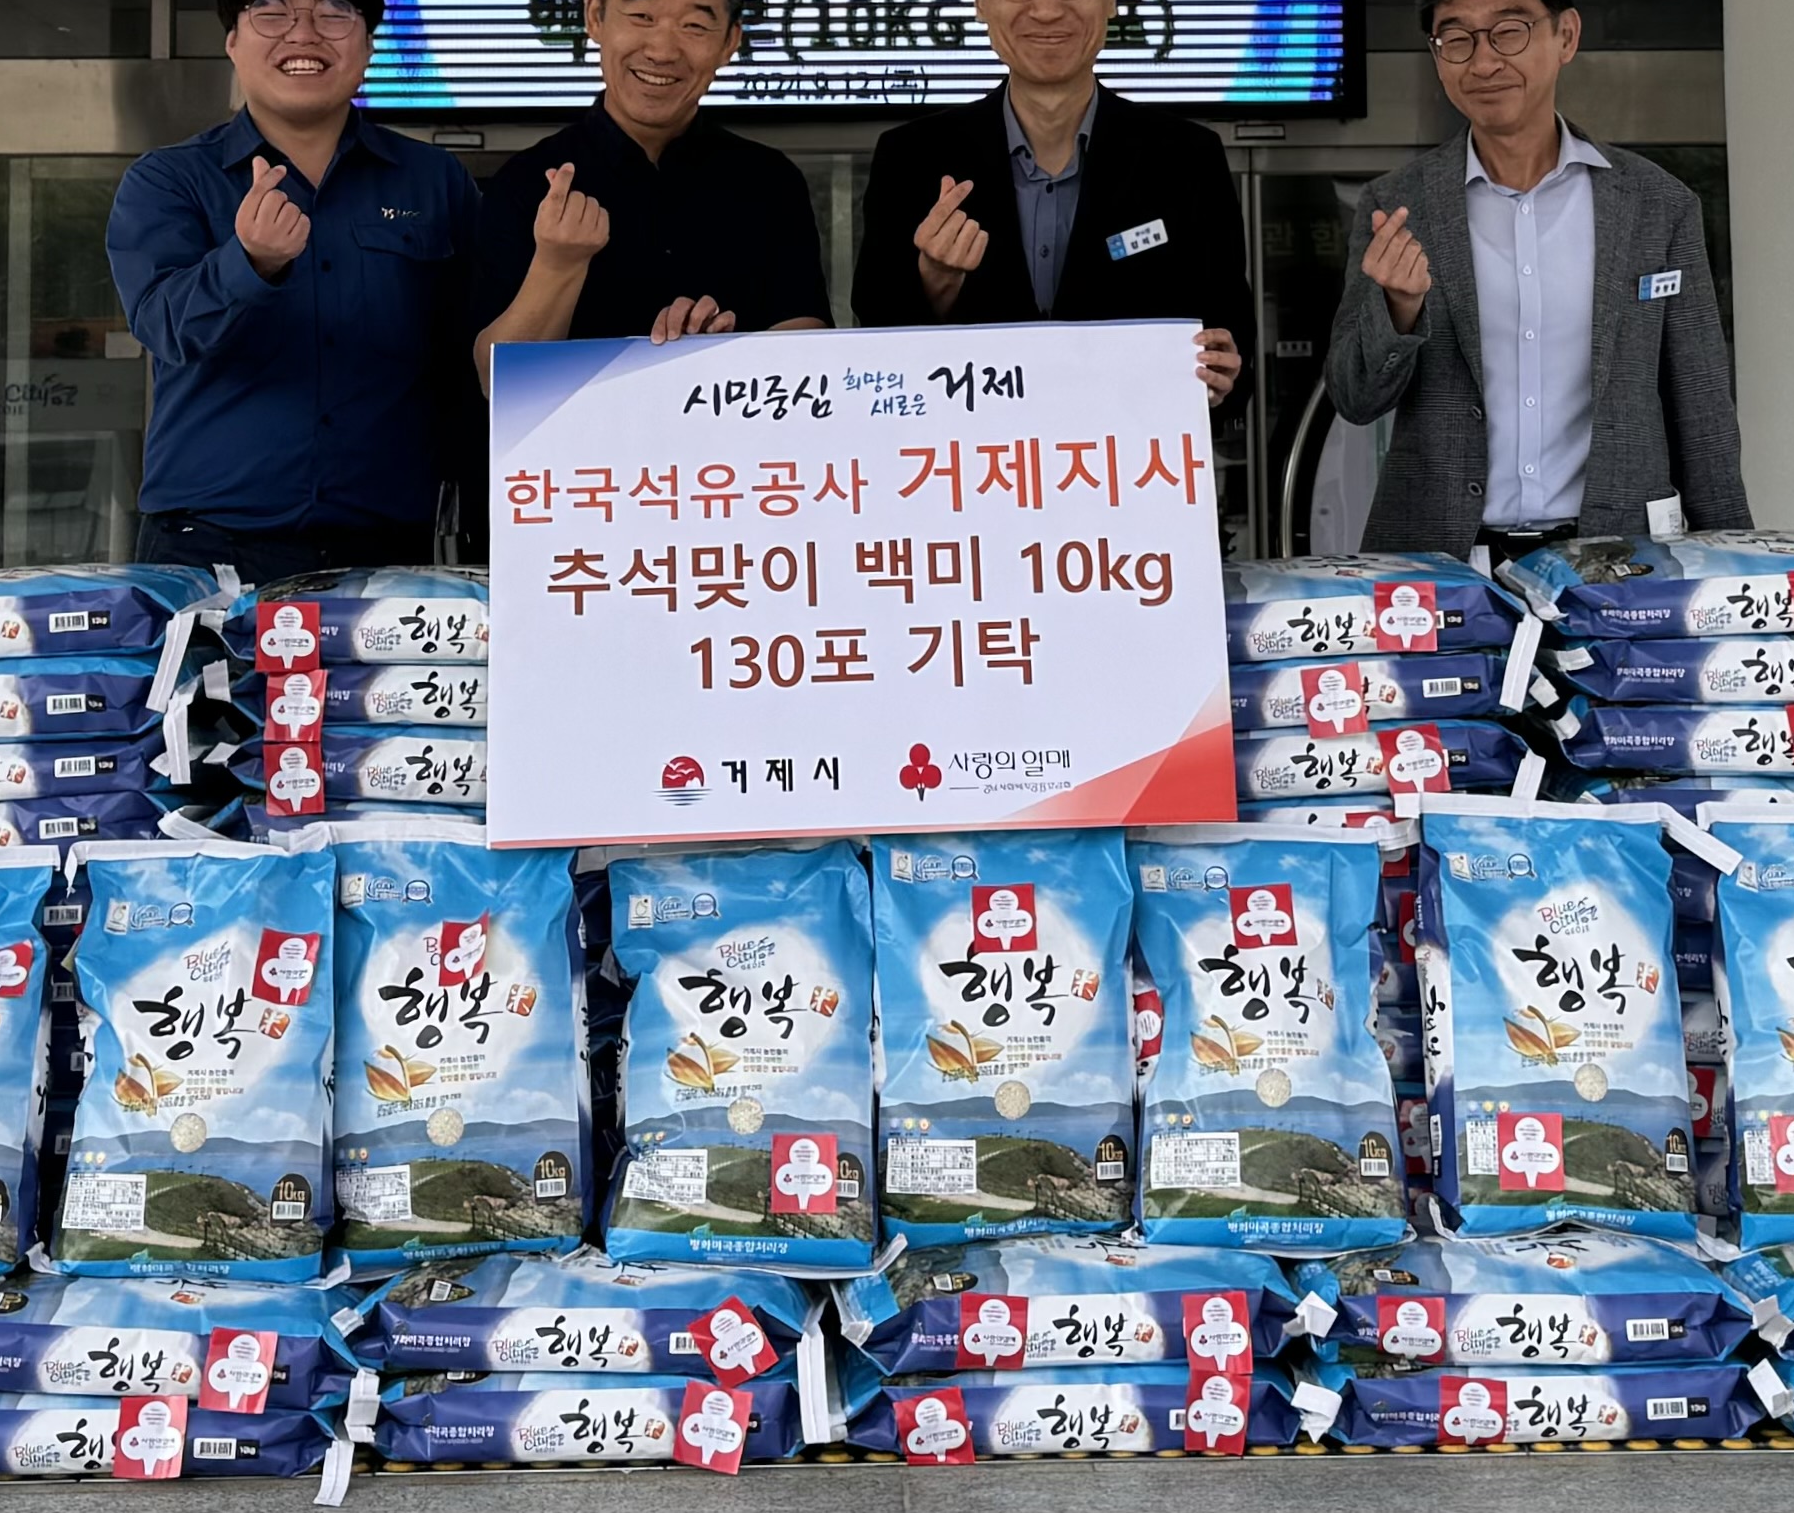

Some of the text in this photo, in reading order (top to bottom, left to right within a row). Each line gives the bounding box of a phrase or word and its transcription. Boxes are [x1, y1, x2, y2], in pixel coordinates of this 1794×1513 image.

[682, 368, 905, 421] 시민중심 희망의
[871, 393, 927, 418] 새로운
[927, 362, 1025, 413] 거제
[505, 432, 1204, 525] 한국석유공사 거제지사
[546, 536, 1174, 616] 추석맞이 백미 10kg
[399, 604, 475, 653] 행복
[689, 618, 1042, 691] 130포 기탁
[1286, 607, 1362, 653] 행복
[411, 671, 482, 718] 행복
[407, 747, 485, 795] 행복
[721, 756, 840, 795] 거제시
[1291, 744, 1365, 790] 행복
[939, 944, 1069, 1026] 행복
[1198, 944, 1319, 1025] 행복
[1512, 935, 1636, 1015] 행복
[133, 986, 256, 1061] 행복
[379, 967, 504, 1049] 행복
[678, 968, 808, 1040] 행복
[838, 1161, 859, 1180] 0kg
[535, 1316, 618, 1367] 행복
[1053, 1305, 1133, 1357] 행복
[1496, 1304, 1576, 1358] 행복
[87, 1338, 167, 1394] 행복
[559, 1399, 643, 1453] 행복
[1038, 1395, 1118, 1448] 행복
[1514, 1388, 1596, 1438] 행복
